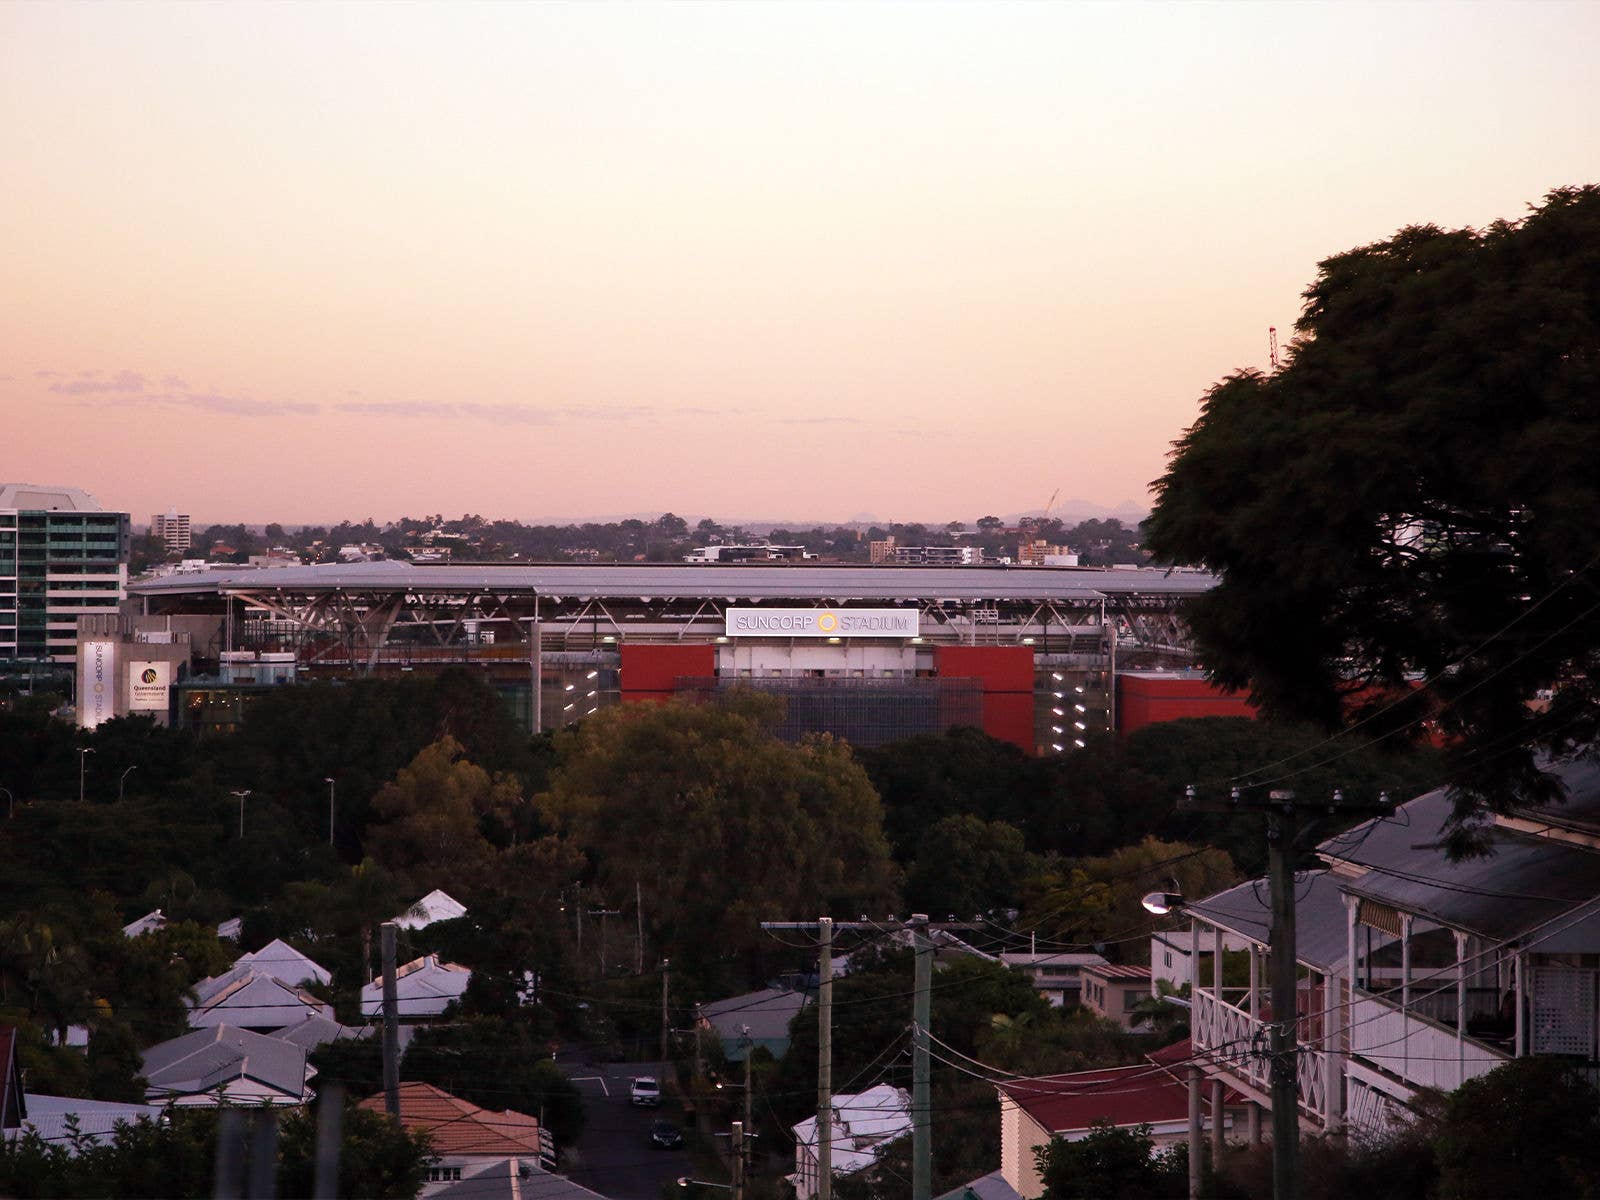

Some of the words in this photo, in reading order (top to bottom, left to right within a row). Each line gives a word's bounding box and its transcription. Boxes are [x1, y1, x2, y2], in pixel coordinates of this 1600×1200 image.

[736, 615, 813, 630] SUNCORP
[840, 615, 908, 631] STADIUM
[95, 645, 103, 682] SUNCORP
